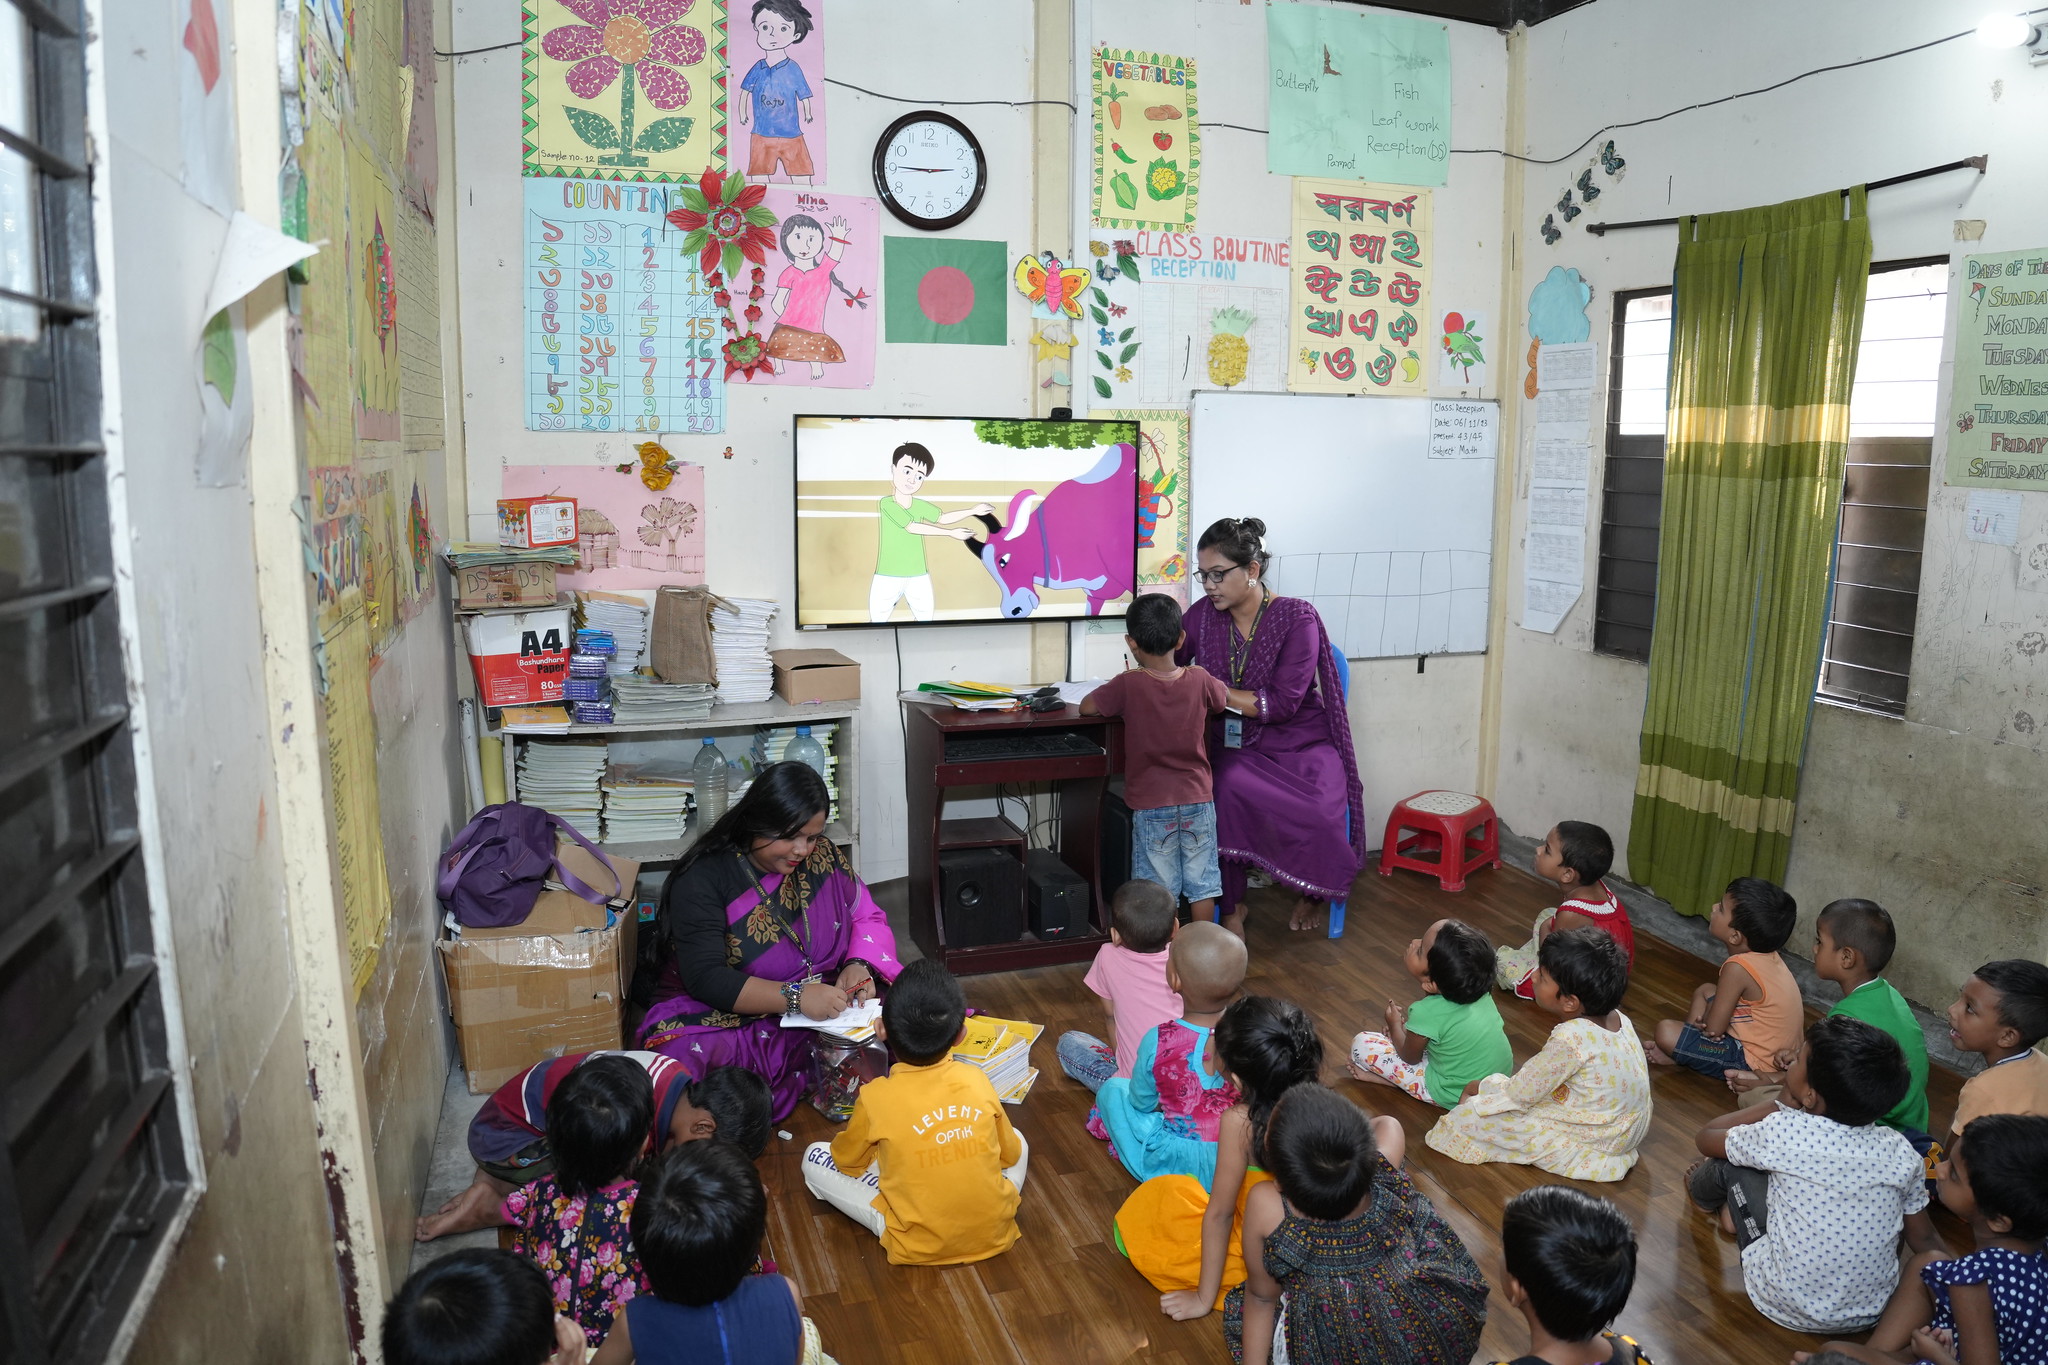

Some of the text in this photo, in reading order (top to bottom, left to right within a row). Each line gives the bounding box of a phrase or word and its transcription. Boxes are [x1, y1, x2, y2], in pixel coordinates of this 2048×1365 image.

[1103, 61, 1184, 86] VEGETABLES
[1276, 69, 1319, 93] Butterfly
[760, 94, 785, 109] Raju
[1394, 83, 1419, 101] Fish
[1372, 109, 1439, 132] Leaf work
[925, 128, 935, 140] 12
[541, 150, 566, 161] Sample
[895, 145, 907, 157] 10
[957, 148, 964, 160] 2
[889, 162, 897, 175] 9
[961, 167, 969, 179] 3
[895, 181, 903, 194] 8
[956, 185, 963, 197] 4
[797, 194, 828, 206] Mina
[909, 196, 916, 207] 7
[926, 201, 934, 213] 6
[943, 198, 951, 209] 5
[1314, 192, 1418, 227] স্বরবর্ণ
[542, 220, 563, 242] ১
[584, 222, 612, 243] ১১
[642, 227, 655, 248] 1
[539, 244, 561, 266] ২
[582, 246, 615, 269] ১২
[643, 247, 659, 269] 2
[1136, 230, 1290, 267] CLASS ROUTINE
[1307, 230, 1423, 268] অ আ ই
[538, 269, 561, 287] ৩
[1151, 258, 1236, 281] RECEPTION
[1968, 260, 2002, 279] DAYS
[2005, 259, 2023, 276] OF
[581, 270, 613, 289] ১৩
[642, 271, 656, 293] 3
[1304, 265, 1421, 308] ঈ উ ঊ
[544, 288, 558, 312] ৪
[579, 292, 607, 314] ১৪
[638, 294, 659, 316] 4
[686, 295, 719, 318] 14
[1988, 286, 2048, 307] SUNDA
[542, 313, 560, 333] ৫
[580, 314, 614, 335] ১৫
[640, 317, 658, 337] 5
[686, 318, 715, 339] 15
[1304, 305, 1418, 347] ঋ এ ঐ
[542, 334, 561, 353] ৬
[580, 335, 616, 357] ১৬
[639, 337, 655, 357] 6
[685, 339, 713, 359] 16
[548, 355, 560, 375] ৭
[580, 356, 609, 376] ১৭
[639, 358, 657, 377] 7
[686, 358, 716, 379] 17
[1323, 343, 1397, 386] ও ঔ
[547, 374, 568, 396] ৮
[579, 376, 619, 396] ১৮
[642, 376, 654, 396] 8
[685, 378, 712, 399] 18
[547, 395, 564, 414] ৯
[580, 395, 612, 414] ১৯
[643, 397, 657, 416] 9
[684, 398, 713, 417] 19
[1456, 404, 1485, 415] Reception
[539, 414, 566, 430] ১০
[582, 415, 610, 431] ২০
[635, 416, 661, 432] 10
[688, 416, 714, 432] 20
[1459, 445, 1478, 455] Math
[1991, 433, 2048, 454] FRIDAY
[1968, 458, 2048, 480] SATURDAY
[467, 565, 540, 593] DS DS
[520, 628, 563, 657] A4
[520, 657, 564, 666] Bashundhara
[537, 664, 565, 674] Paper
[541, 681, 554, 689] 80
[912, 1105, 983, 1135] LEVENT
